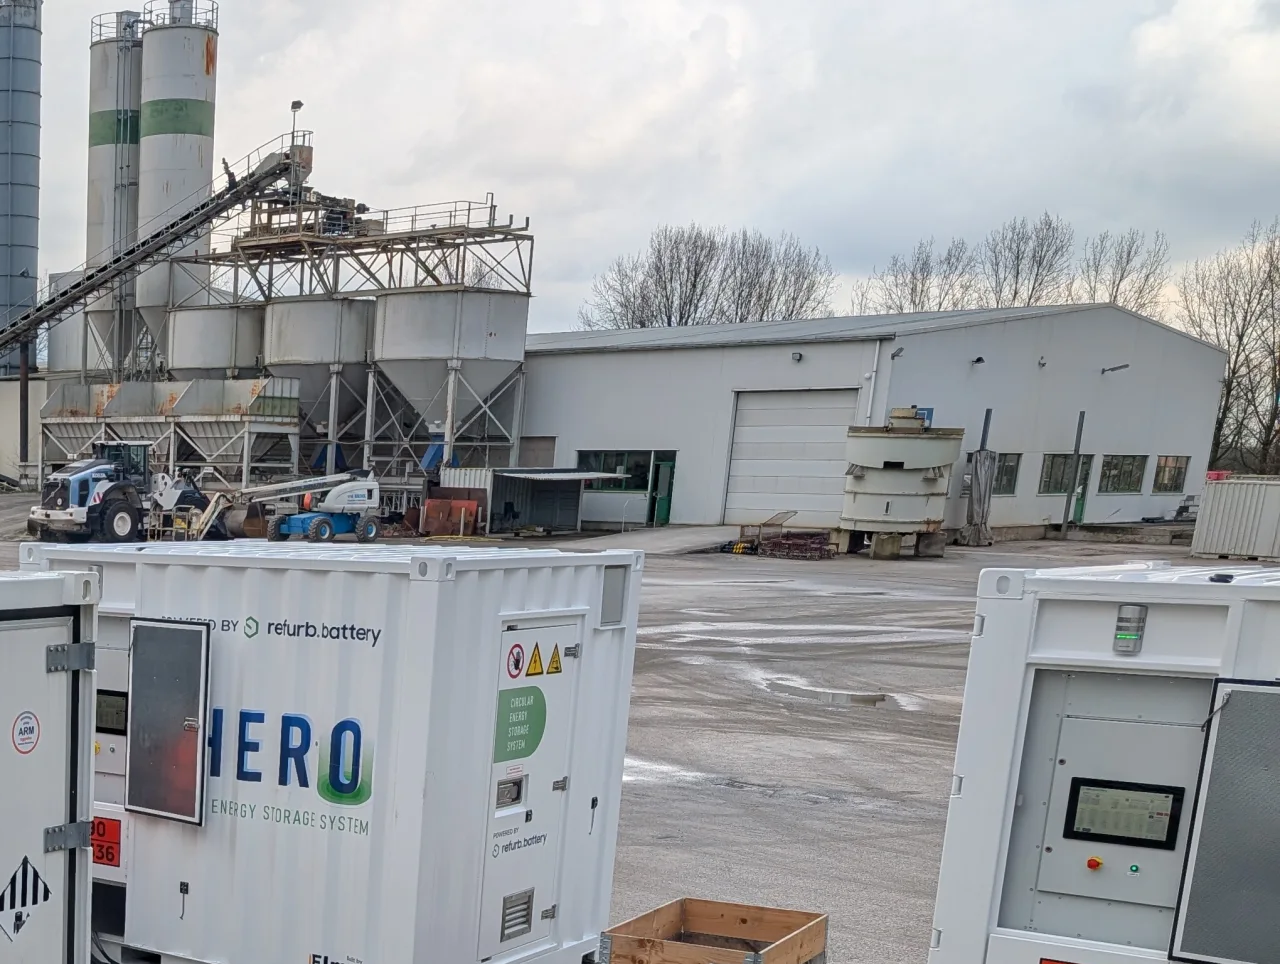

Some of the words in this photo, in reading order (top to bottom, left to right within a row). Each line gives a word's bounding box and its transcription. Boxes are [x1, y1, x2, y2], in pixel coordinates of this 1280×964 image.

[220, 619, 239, 632] BY
[267, 619, 382, 648] refurb.battery
[510, 695, 534, 709] CIRCULAR
[509, 710, 528, 723] ENERGY
[18, 725, 35, 736] ARM
[508, 724, 530, 738] STORAGE
[506, 739, 526, 752] SYSTEM
[211, 799, 257, 820] ENERGY
[263, 805, 316, 828] STORAGE
[320, 814, 369, 836] SYSTEM
[501, 833, 548, 854] refurb.battery
[91, 843, 115, 863] 36
